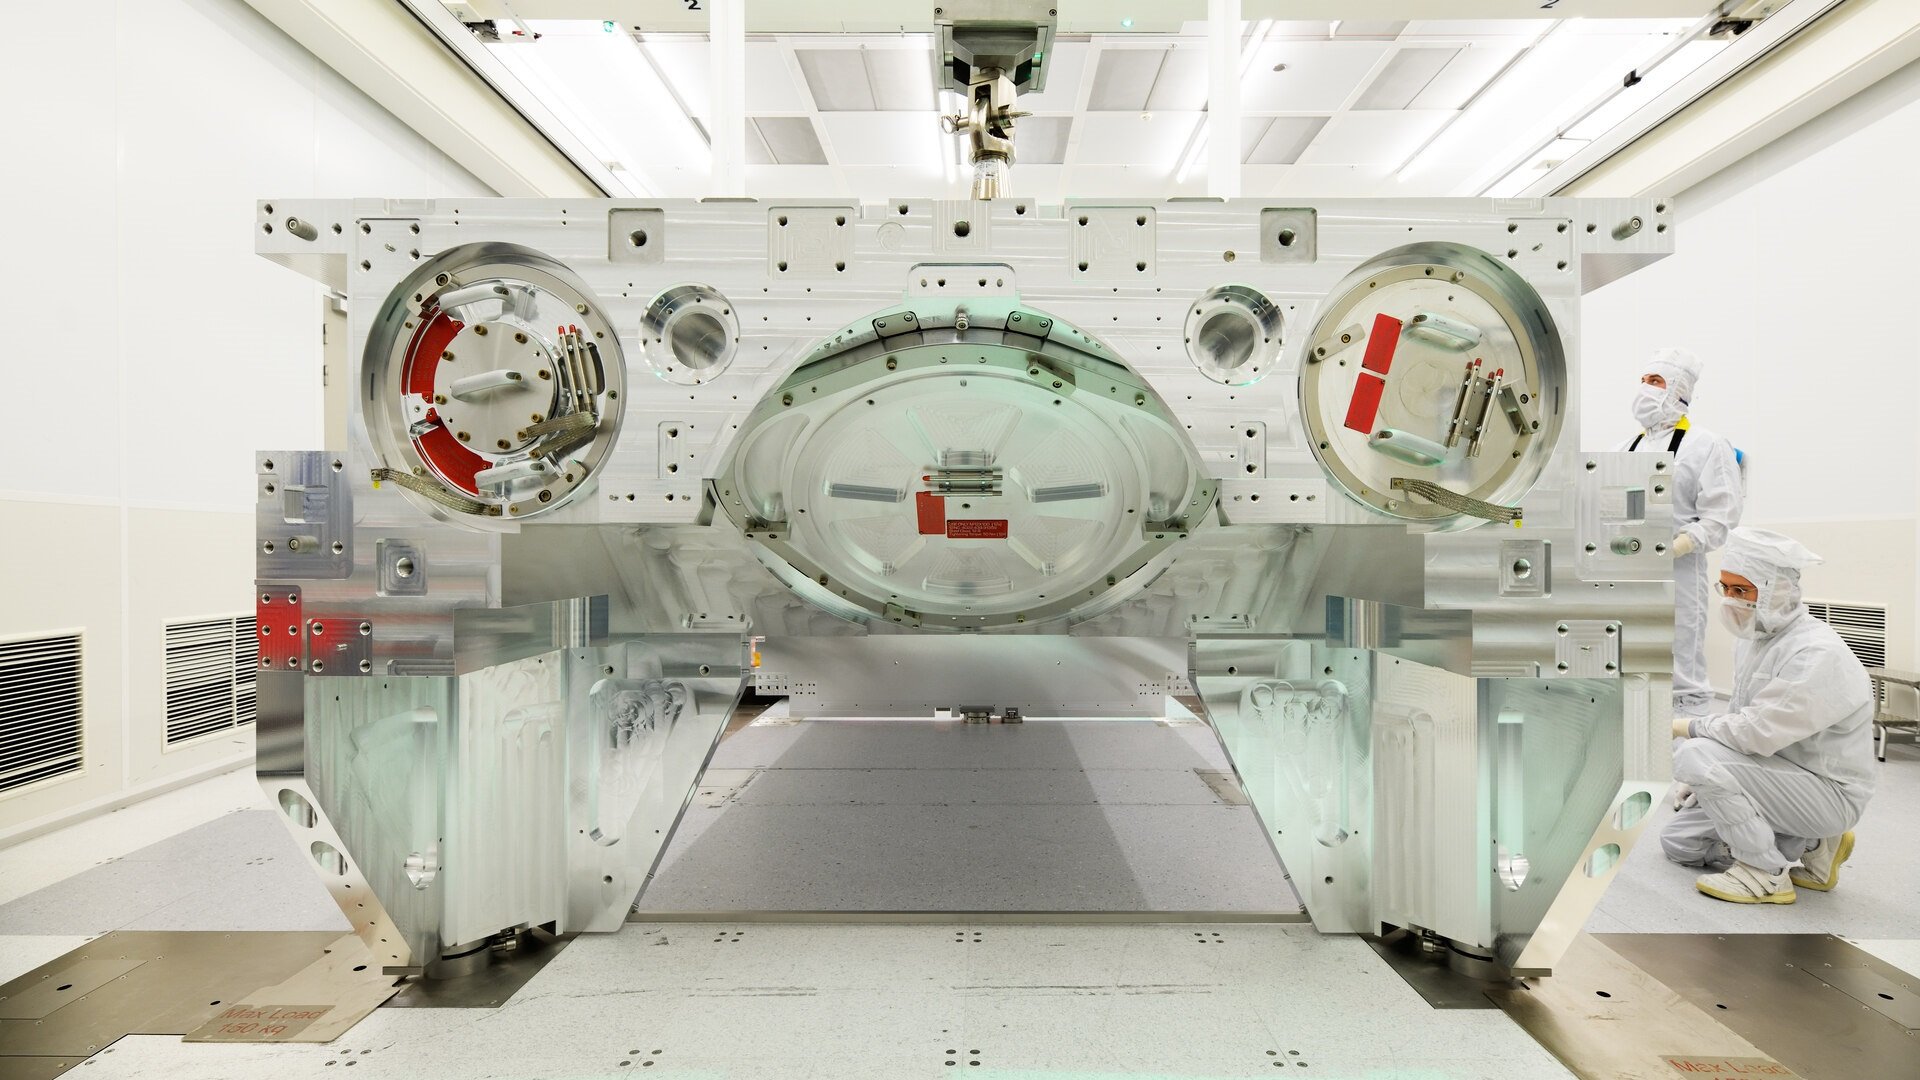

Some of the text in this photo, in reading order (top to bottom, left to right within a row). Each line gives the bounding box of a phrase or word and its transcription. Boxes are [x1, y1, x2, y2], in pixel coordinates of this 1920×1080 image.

[220, 1008, 328, 1019] Max Load
[217, 1022, 288, 1036] 150 kg
[1668, 1059, 1792, 1075] Max Load
